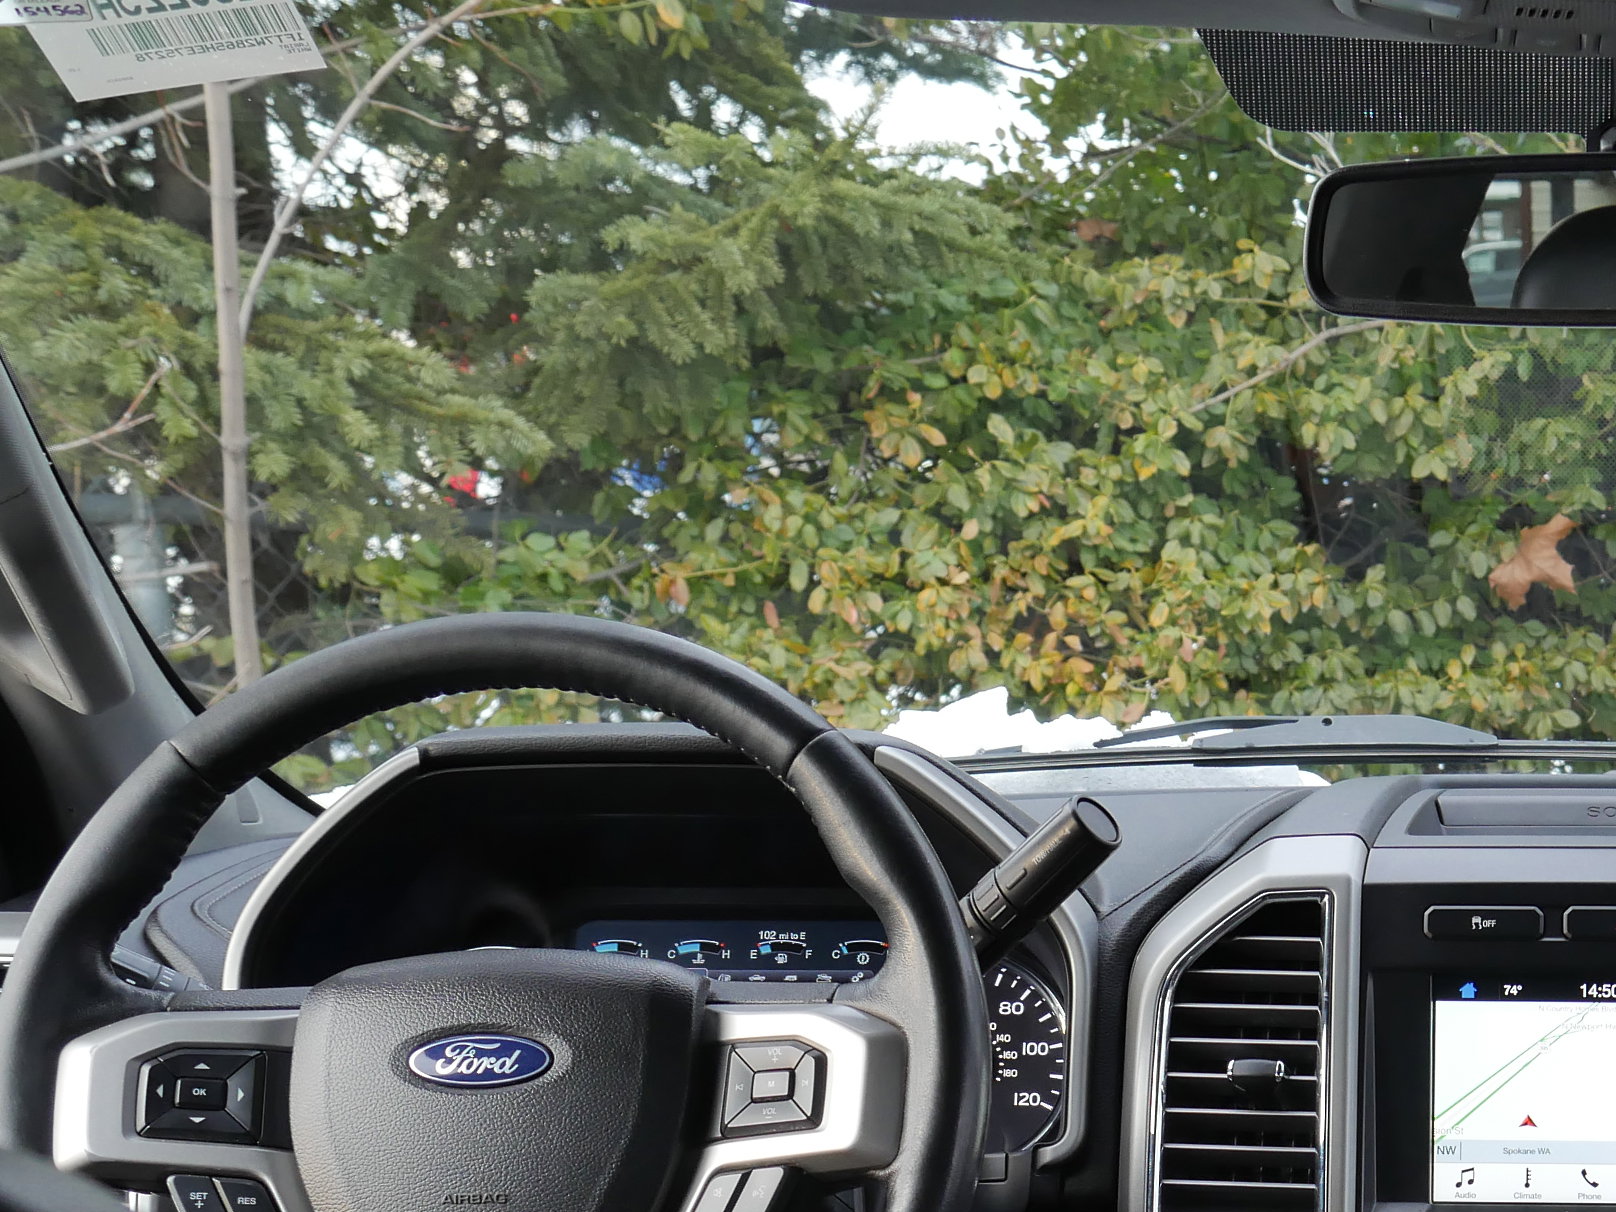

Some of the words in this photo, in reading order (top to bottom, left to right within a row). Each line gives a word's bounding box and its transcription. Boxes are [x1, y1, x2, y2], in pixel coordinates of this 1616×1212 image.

[1482, 918, 1497, 928] OFF
[758, 930, 777, 940] 102
[778, 931, 790, 940] mi
[790, 931, 799, 940] to
[799, 931, 807, 940] E
[640, 950, 648, 959] H
[667, 950, 676, 959] C
[721, 950, 731, 959] H
[750, 951, 758, 959] E
[805, 951, 813, 960] F
[831, 950, 840, 959] C
[1503, 984, 1523, 996] 74°
[998, 1001, 1025, 1016] 80
[996, 1034, 1012, 1043] 140
[767, 1048, 782, 1056] VOL
[1022, 1042, 1049, 1056] 100
[434, 1040, 522, 1076] Ford
[1003, 1051, 1018, 1060] 160
[1003, 1068, 1018, 1078] 180
[767, 1080, 775, 1088] M
[192, 1087, 207, 1097] OK
[1013, 1091, 1041, 1106] 120
[762, 1107, 777, 1115] VOL
[1436, 1145, 1457, 1156] NW
[1502, 1147, 1536, 1156] Spokane
[1536, 1147, 1551, 1155] WA
[189, 1191, 209, 1201] SET
[442, 1193, 508, 1205] AIRBAG
[1454, 1191, 1477, 1200] Audio
[1513, 1191, 1543, 1200] Climate
[1577, 1192, 1602, 1201] Phone
[237, 1196, 257, 1206] RES
